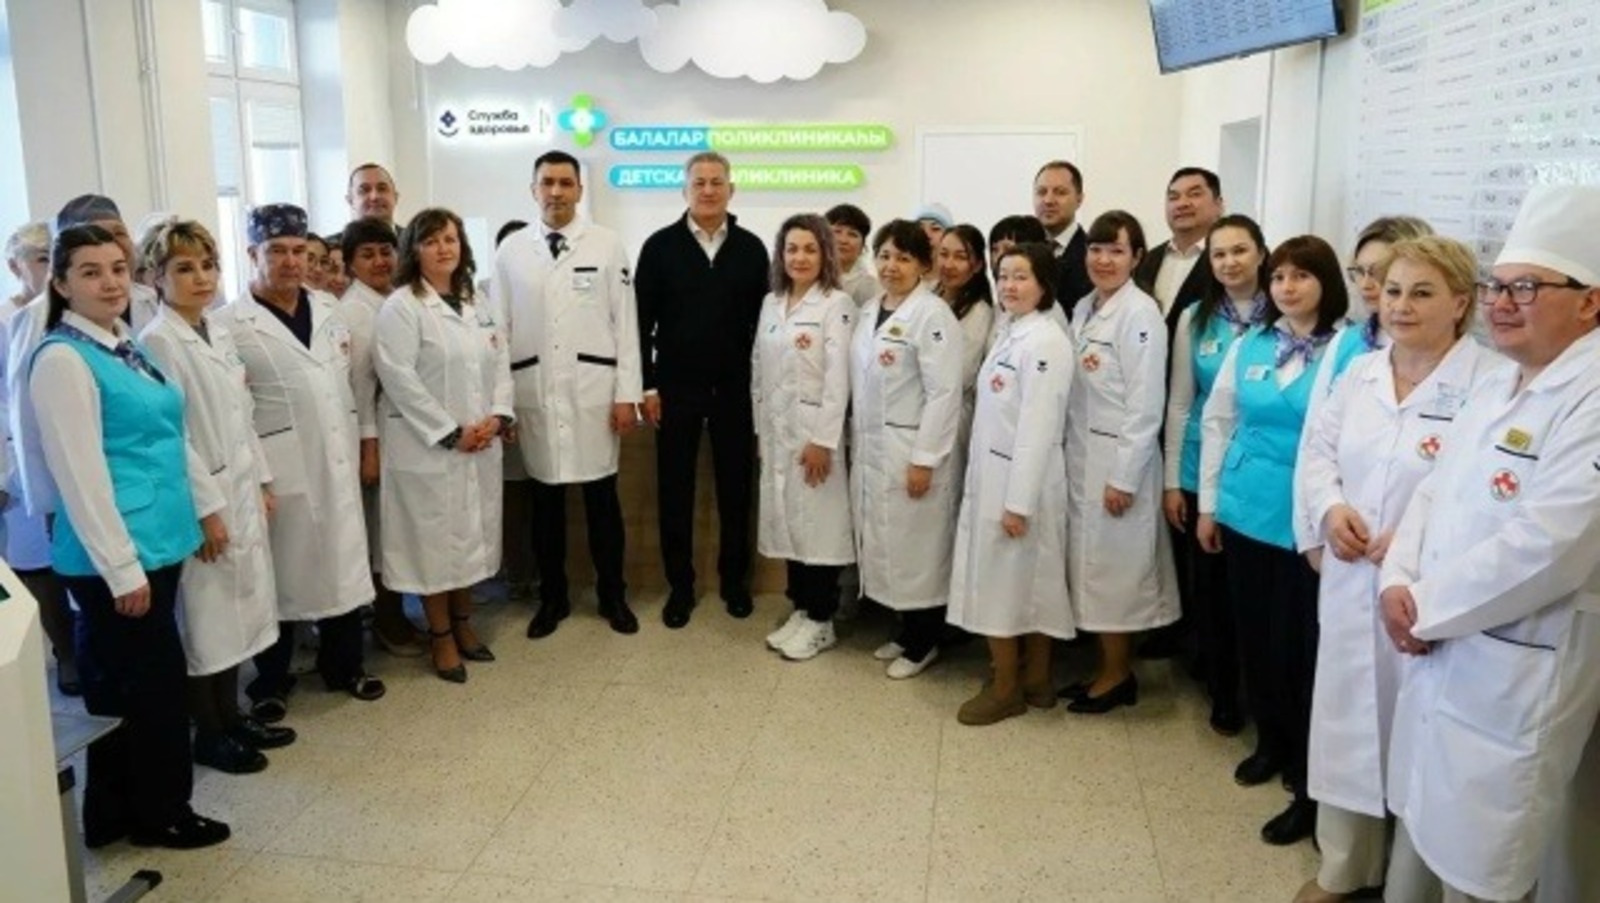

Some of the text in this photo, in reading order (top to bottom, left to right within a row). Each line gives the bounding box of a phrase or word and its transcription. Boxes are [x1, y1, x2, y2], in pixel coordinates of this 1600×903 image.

[467, 110, 519, 122] Служба
[613, 130, 704, 147] БАЛАЛАР
[617, 168, 685, 186] ДЕТСКА
